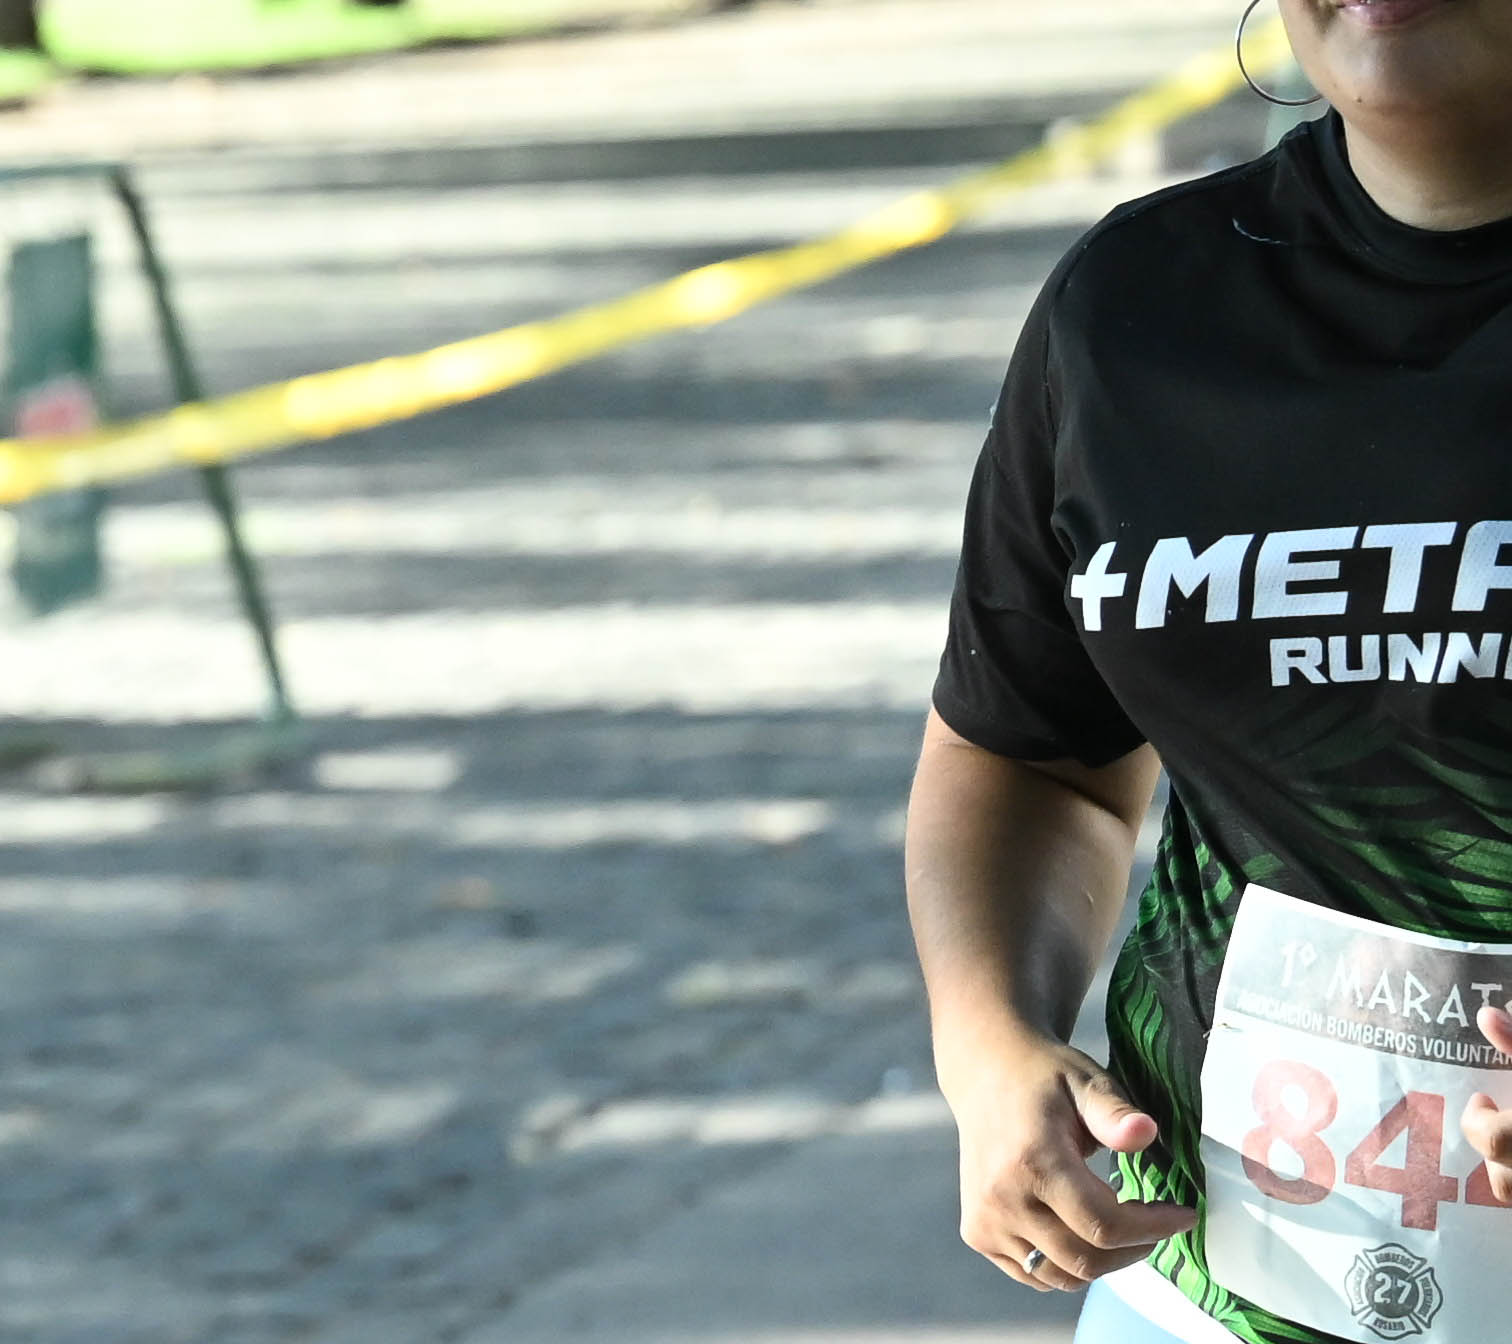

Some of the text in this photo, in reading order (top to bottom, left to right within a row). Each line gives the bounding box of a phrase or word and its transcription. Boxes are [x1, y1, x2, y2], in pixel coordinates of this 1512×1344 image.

[1269, 630, 1512, 687] RUNN
[1325, 953, 1512, 1029] MARAT
[1325, 1015, 1418, 1055] BOMBEROS
[1240, 1059, 1512, 1232] 84
[1373, 1271, 1413, 1305] 27
